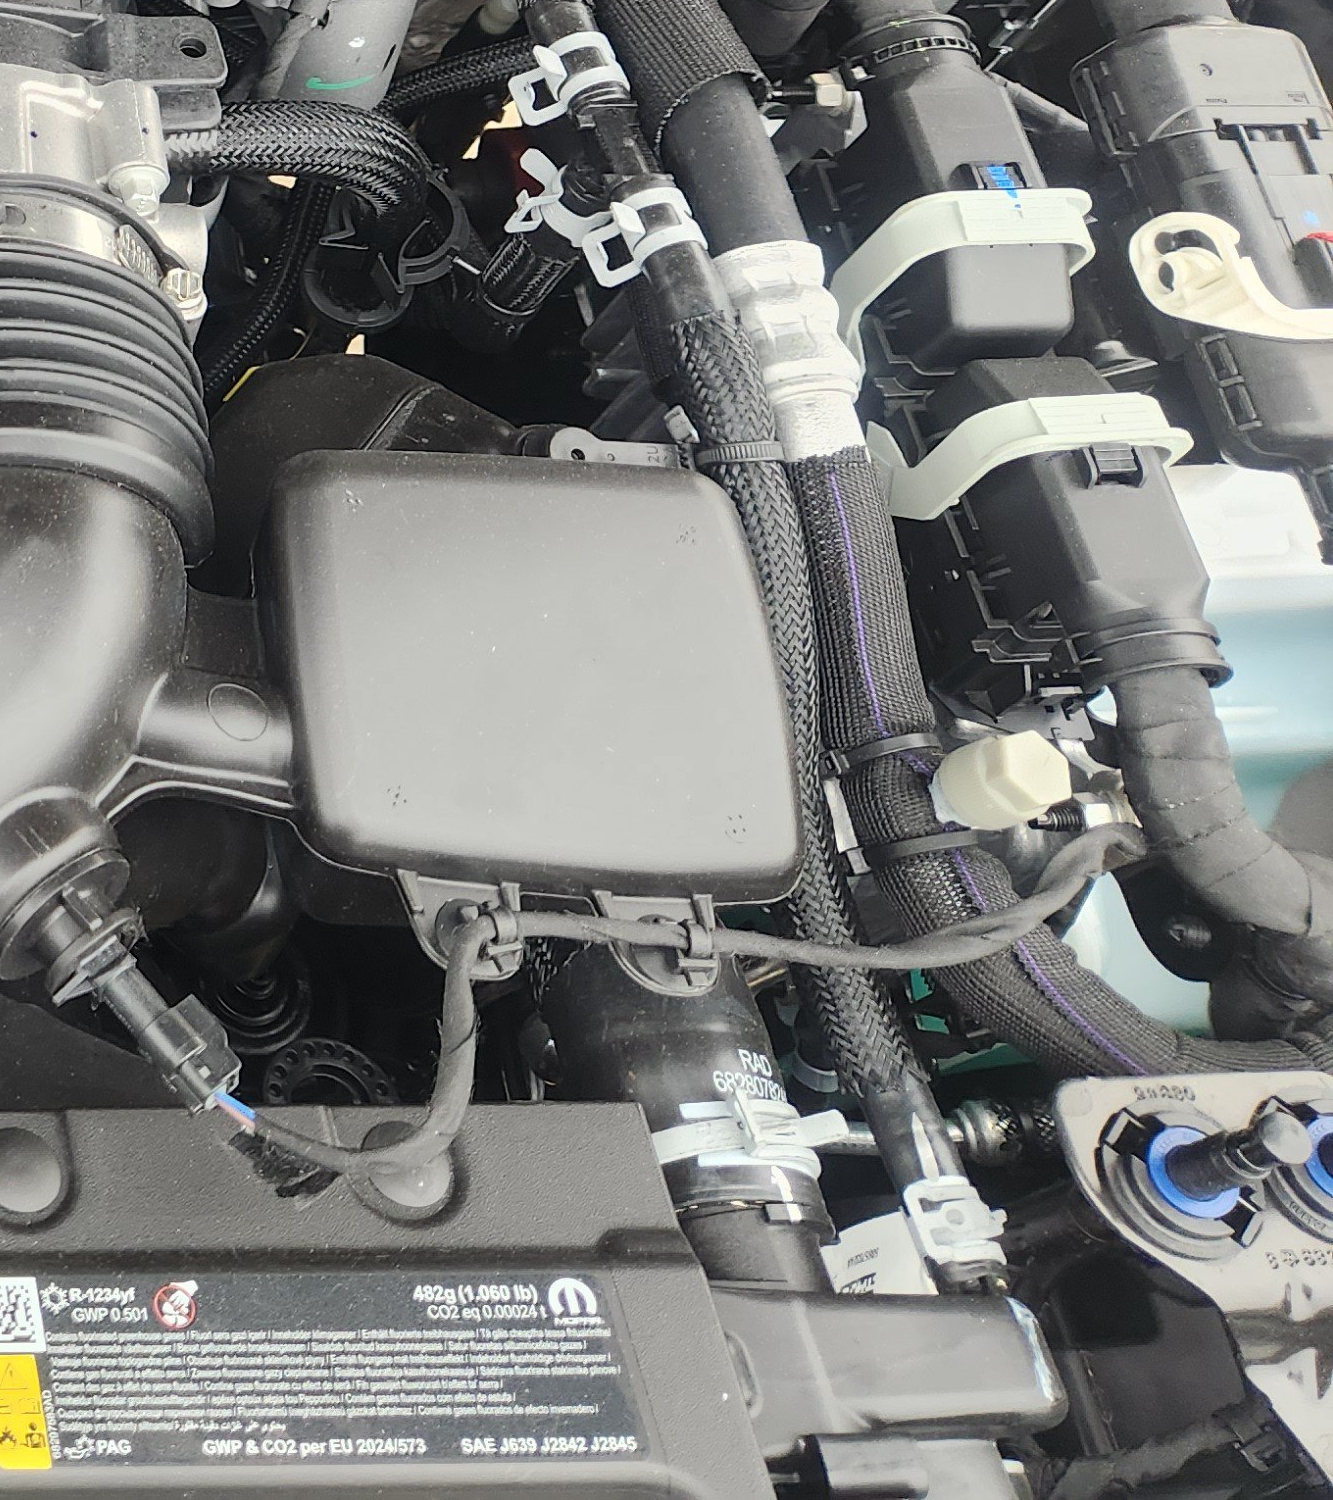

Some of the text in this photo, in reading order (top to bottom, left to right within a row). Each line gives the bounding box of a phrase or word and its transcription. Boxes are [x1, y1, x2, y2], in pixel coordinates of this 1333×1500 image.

[737, 1048, 773, 1078] RAD
[68, 1284, 538, 1306] R-1234yf 482g (1.060 lb)
[71, 1306, 109, 1324] GWP
[110, 1306, 149, 1324] 0.501
[427, 1304, 460, 1320] CO2
[462, 1307, 482, 1323] eq
[483, 1304, 538, 1321] 0.00024
[96, 1434, 638, 1460] PAG GWP & CO2 per EU 2024/573 SAE J639 J2842 J2845
